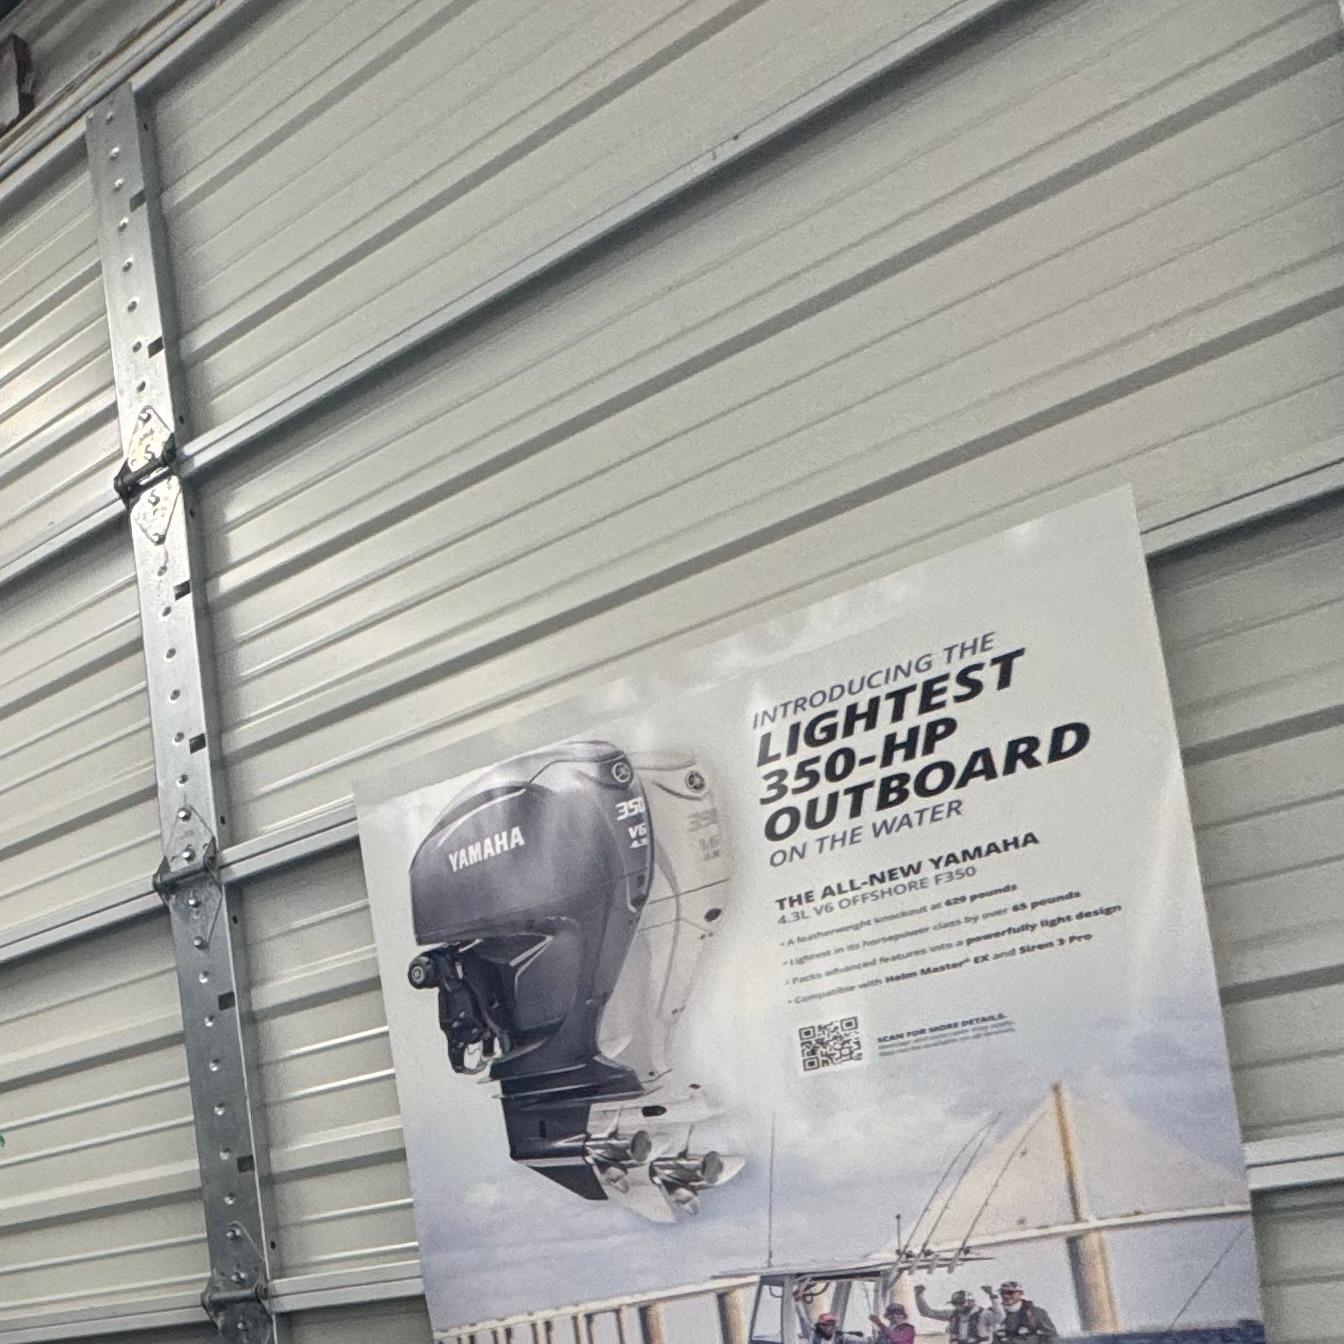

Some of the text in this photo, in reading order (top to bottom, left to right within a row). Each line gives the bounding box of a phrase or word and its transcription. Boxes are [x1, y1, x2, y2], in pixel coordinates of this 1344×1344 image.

[752, 631, 996, 729] INTRODUCING THE
[757, 647, 1026, 767] LIGHTEST
[759, 717, 957, 805] 350-HP
[764, 721, 1091, 842] OUTBOARD
[448, 825, 526, 873] YAMAHA
[768, 799, 963, 868] ON THE WATER
[776, 831, 1040, 912] THE ALL-NEW YAMAHA
[777, 865, 977, 925] 4.3L V6 OFFSHORE F350
[969, 883, 1018, 903] pounds
[1030, 890, 1081, 910] pounds
[966, 922, 1038, 947] powerfully
[1040, 914, 1072, 928] light
[1075, 903, 1122, 921] design
[885, 970, 917, 983] Helm
[973, 953, 990, 964] EX
[992, 948, 1017, 961] and
[1019, 940, 1054, 955] Siren
[1057, 937, 1065, 946] 3
[1068, 932, 1093, 944] Pro
